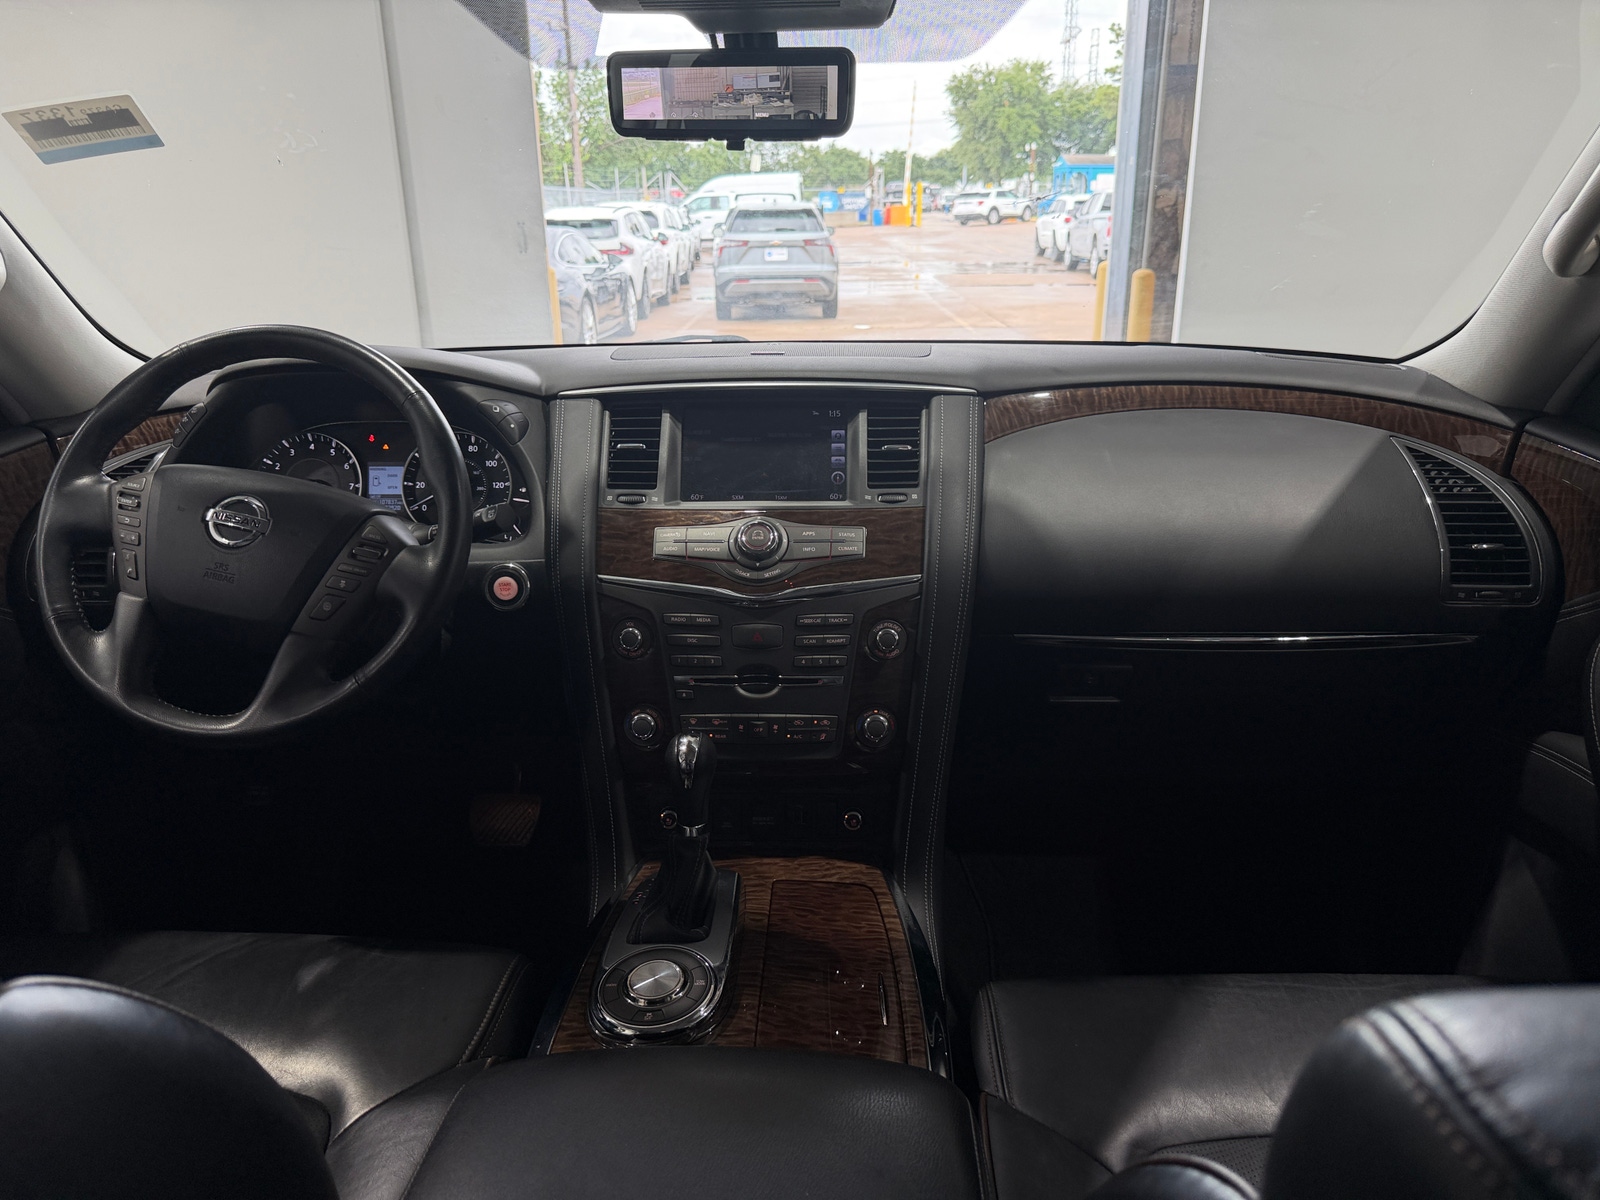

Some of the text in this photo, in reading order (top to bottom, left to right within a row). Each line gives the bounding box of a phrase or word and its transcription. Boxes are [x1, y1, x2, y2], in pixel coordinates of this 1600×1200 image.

[828, 409, 841, 417] 1:15
[309, 442, 315, 450] 4
[289, 448, 295, 456] 3
[329, 448, 336, 456] 5
[274, 462, 281, 470] 2
[343, 462, 350, 470] 6
[348, 482, 355, 490] 7
[415, 481, 426, 489] 20
[212, 510, 261, 528] NISSAN
[213, 561, 230, 572] SRS
[202, 571, 235, 585] AIRBAG
